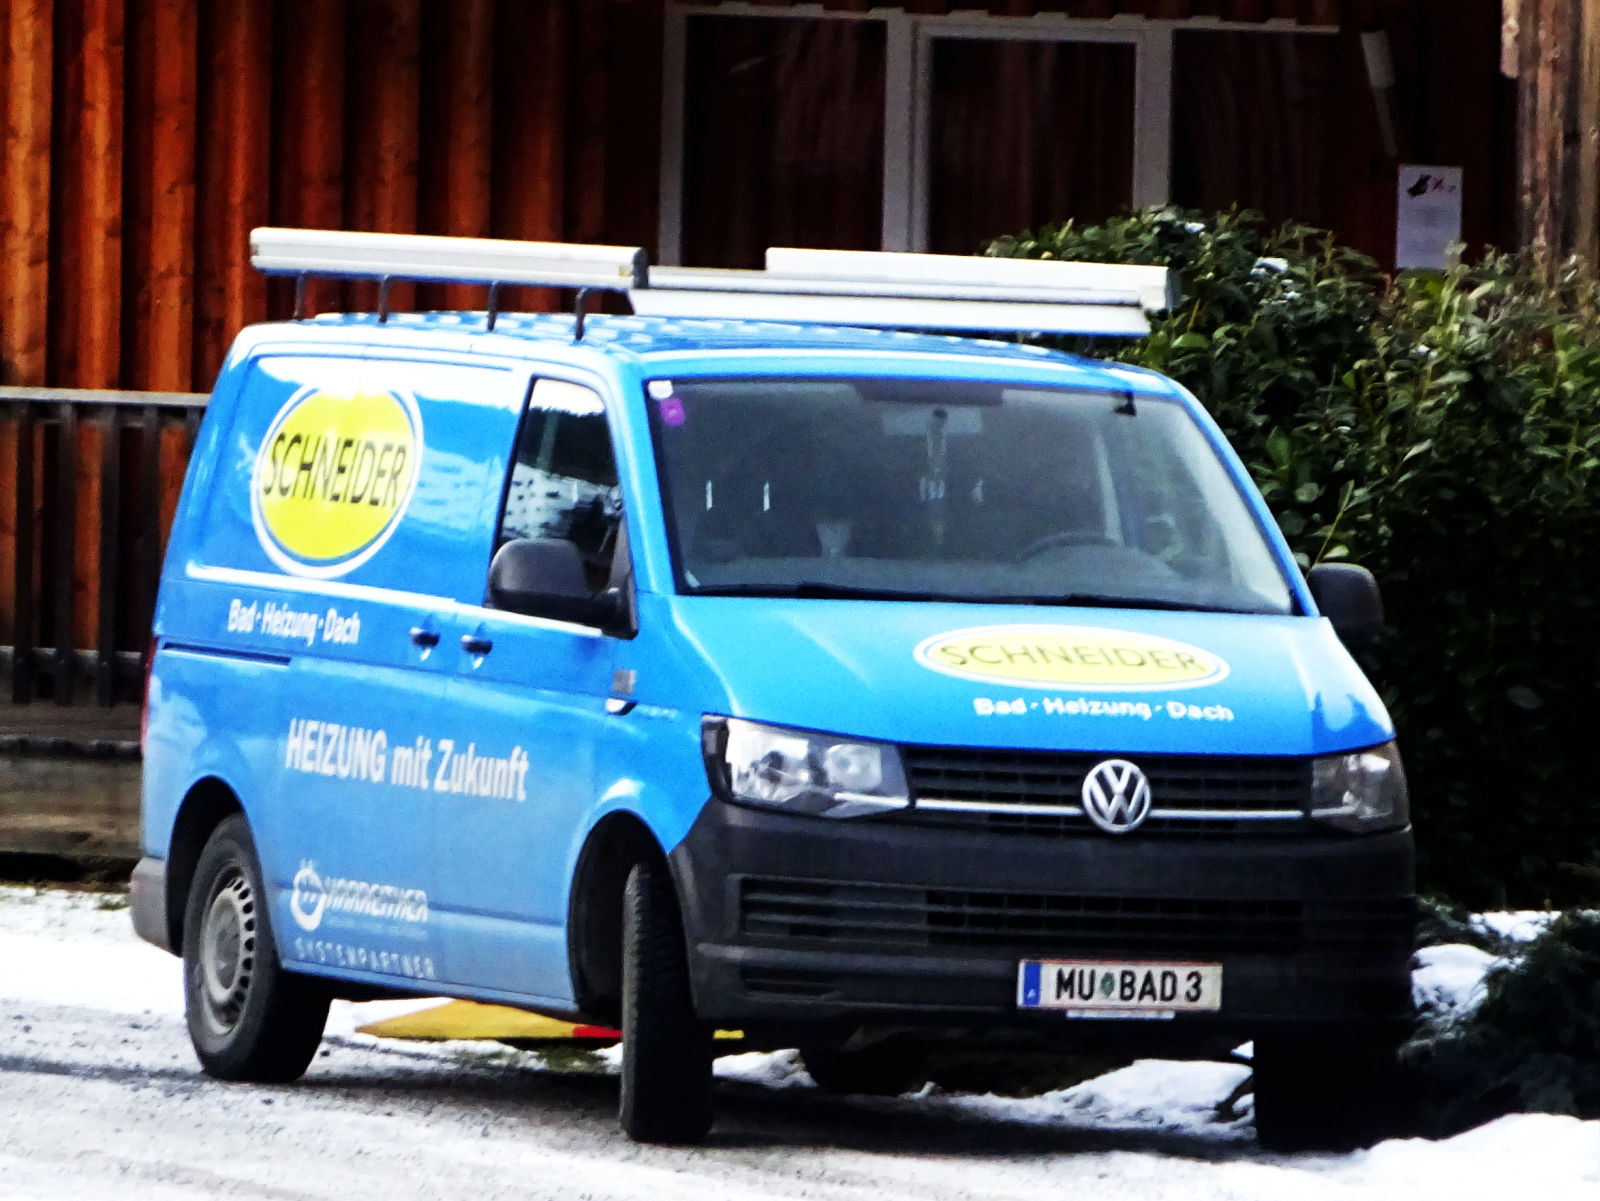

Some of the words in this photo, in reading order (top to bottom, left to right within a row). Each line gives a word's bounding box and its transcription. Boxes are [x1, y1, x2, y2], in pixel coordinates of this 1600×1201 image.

[264, 432, 406, 507] SCHNEIDER
[227, 598, 257, 632] Bad
[261, 601, 318, 646] Heizung
[322, 608, 360, 644] Dach
[940, 645, 1207, 672] SCHNEIDER
[973, 697, 1028, 716] Bad
[1043, 697, 1152, 720] Heizung
[1166, 701, 1235, 721] Dach
[285, 717, 388, 784] HEIZUNG
[390, 735, 433, 790] mit
[433, 738, 529, 802] Zukunft
[1055, 968, 1096, 1001] MU
